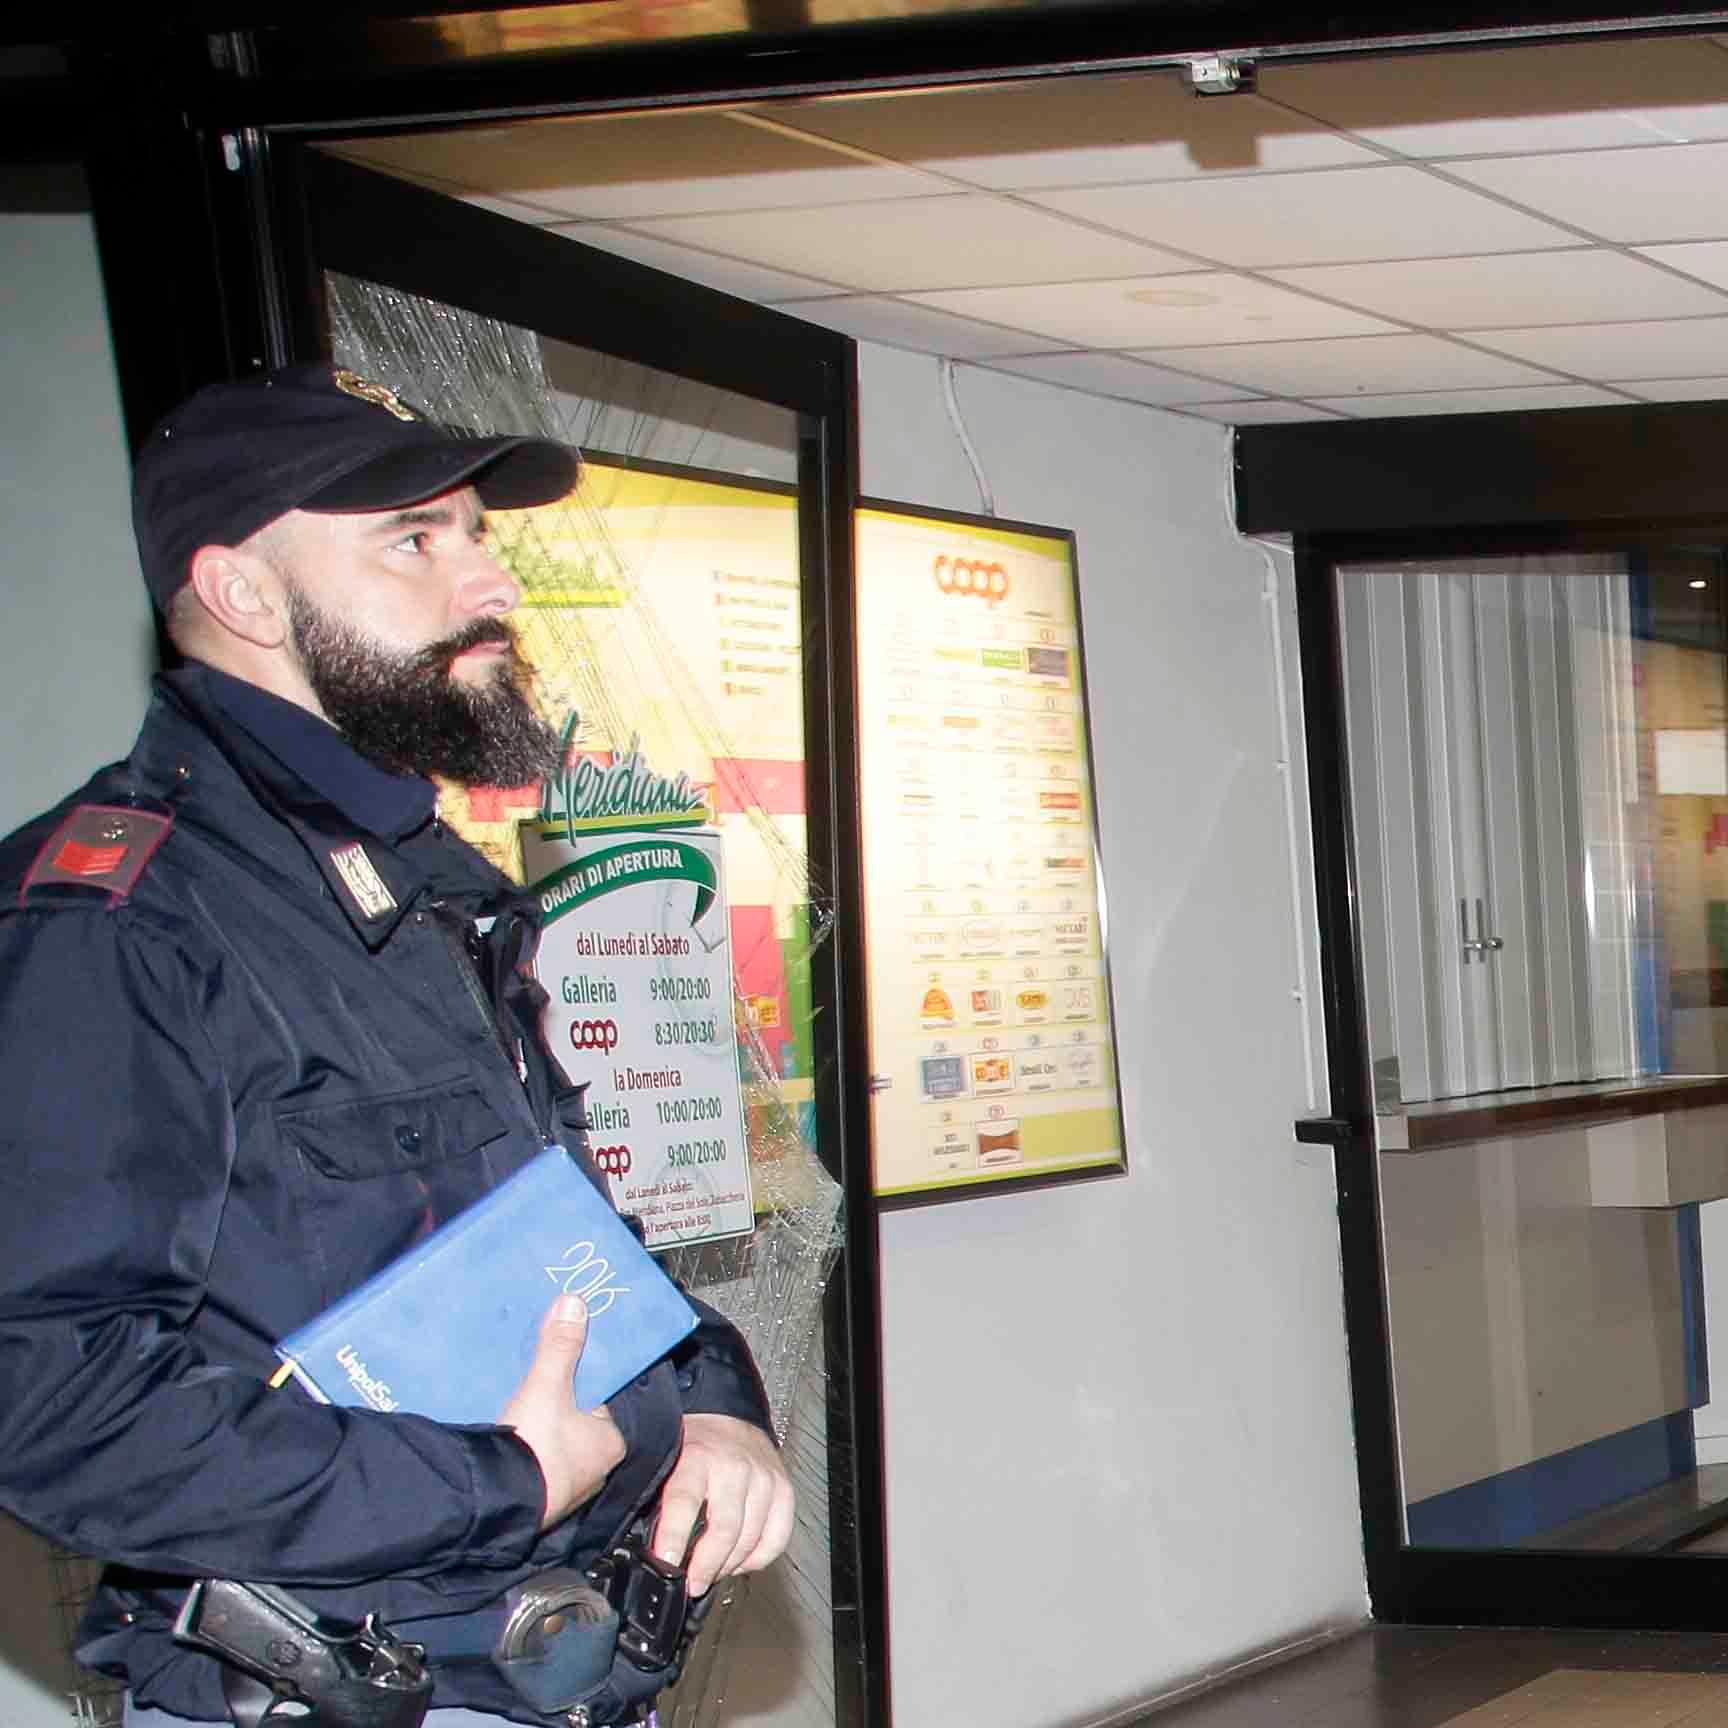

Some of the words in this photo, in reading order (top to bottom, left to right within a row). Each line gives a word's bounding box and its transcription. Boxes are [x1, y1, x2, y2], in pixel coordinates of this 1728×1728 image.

[933, 554, 1009, 608] coop
[538, 708, 707, 848] Meridiana
[540, 871, 587, 912] ORARI
[587, 863, 604, 888] DI
[604, 848, 684, 881] APERTURA
[576, 931, 596, 957] dal
[638, 932, 650, 956] al
[651, 931, 690, 957] Sabato
[561, 974, 617, 1005] Galleria
[649, 977, 711, 1001] 9:00/20:00
[569, 1018, 619, 1056] coop
[654, 1020, 715, 1046] 8:30/20:30
[613, 1068, 625, 1092] la
[625, 1065, 682, 1091] Domenica
[587, 1101, 631, 1133] alleria
[655, 1097, 722, 1126] 10:00/20:00
[595, 1145, 632, 1182] oop
[667, 1139, 727, 1168] 9:00/20:00
